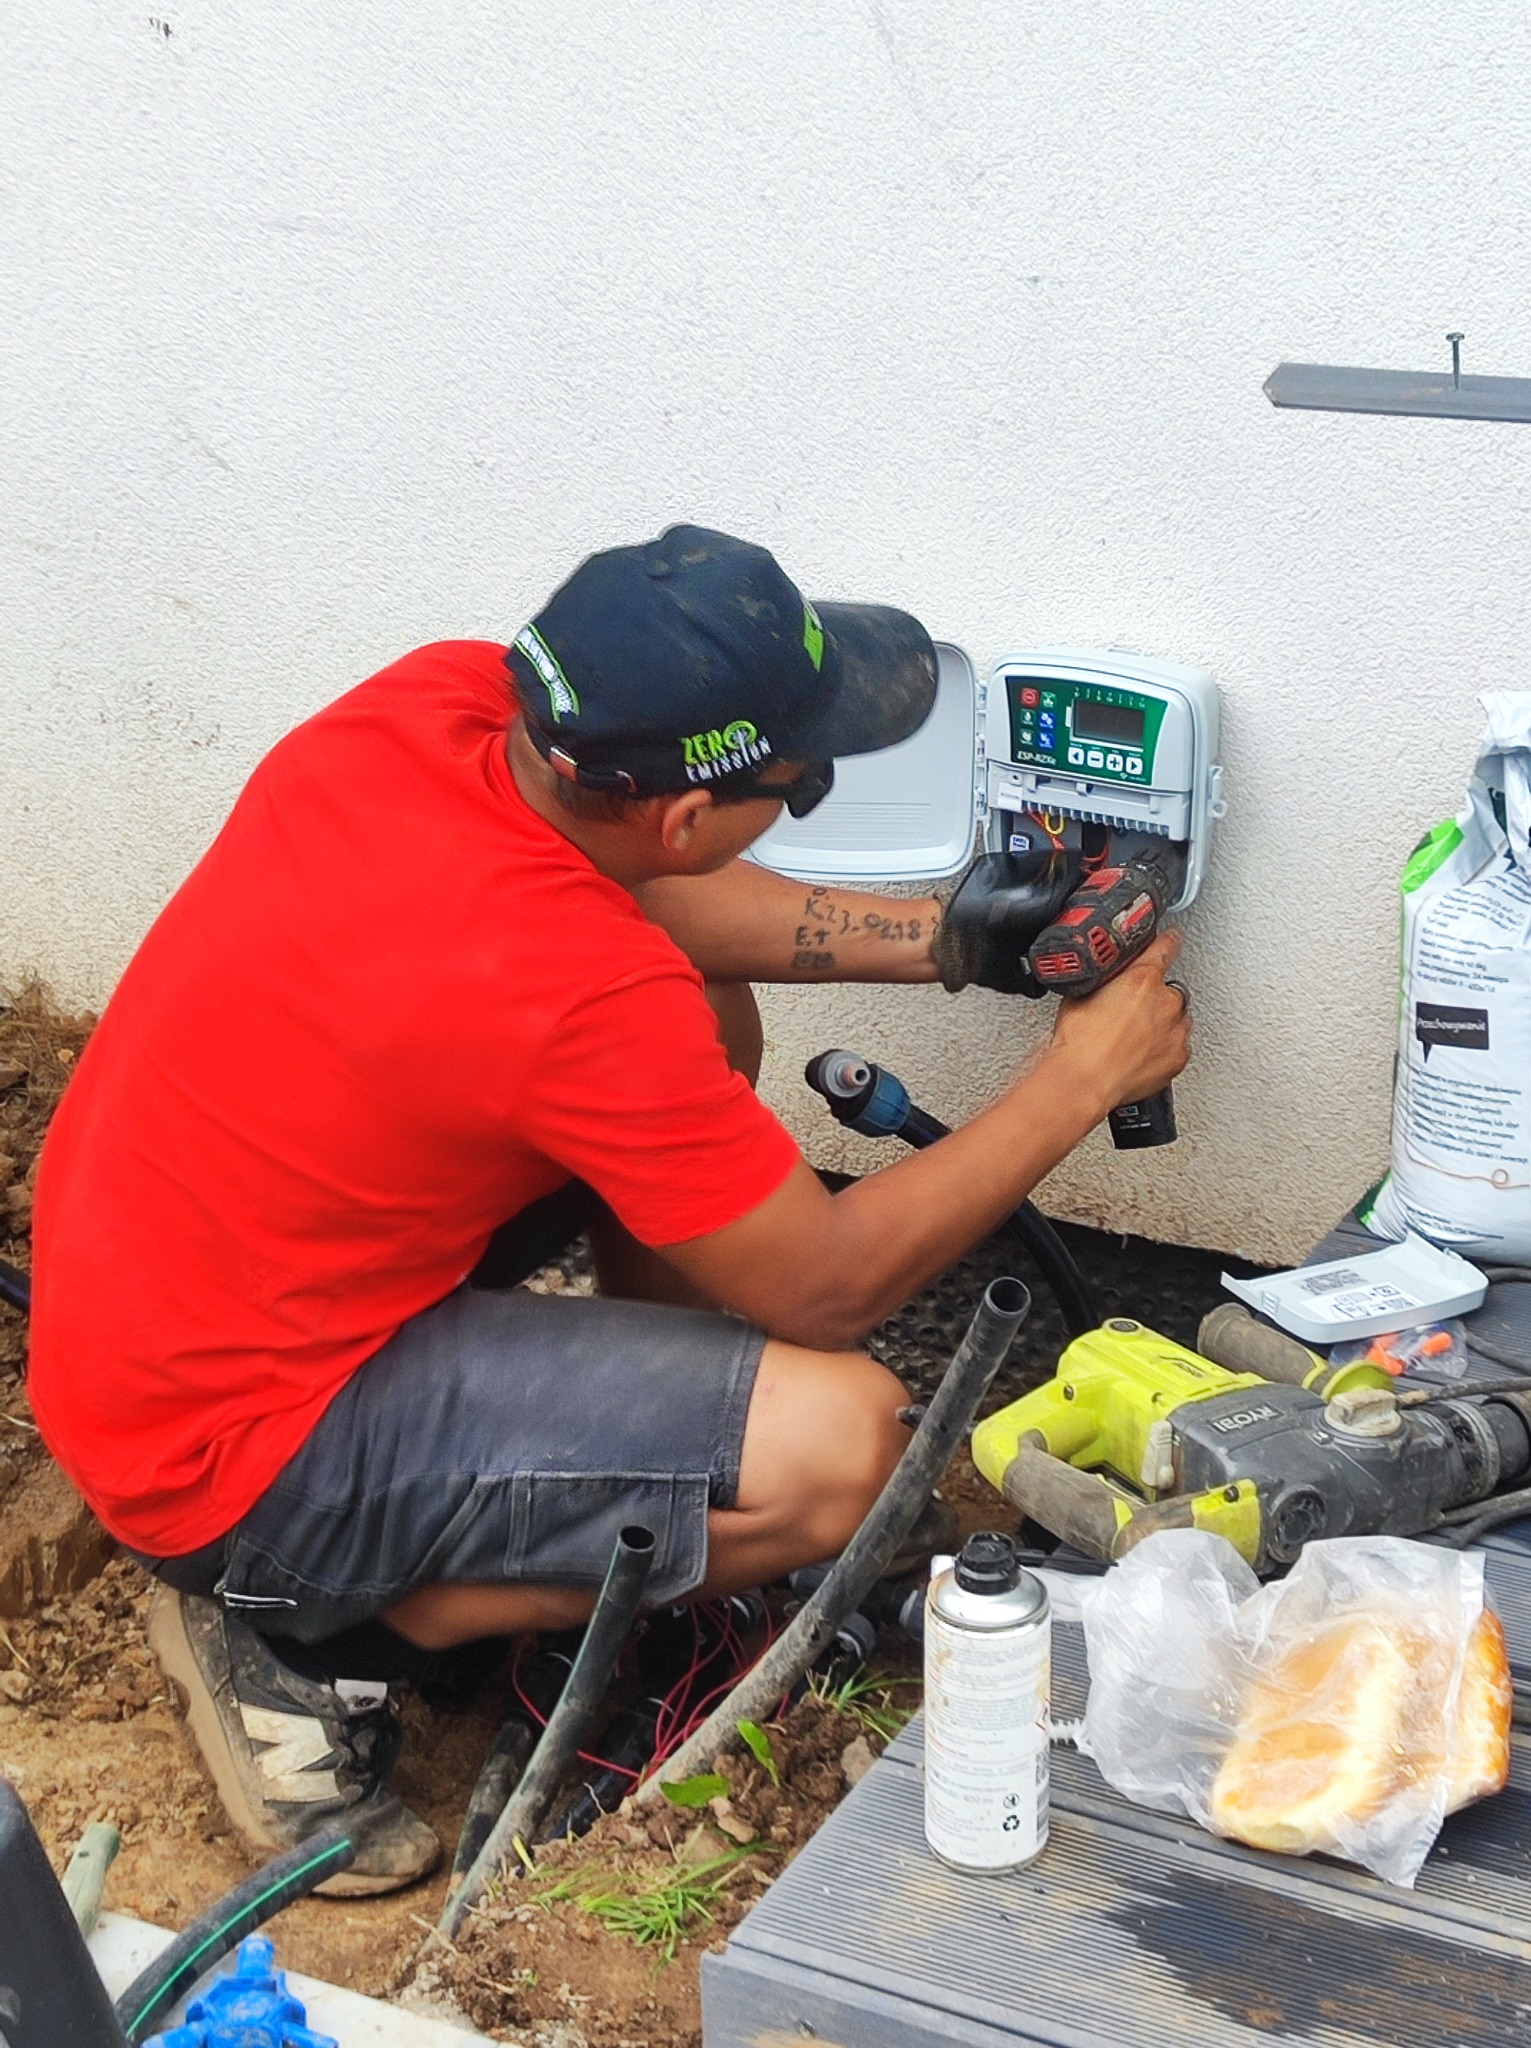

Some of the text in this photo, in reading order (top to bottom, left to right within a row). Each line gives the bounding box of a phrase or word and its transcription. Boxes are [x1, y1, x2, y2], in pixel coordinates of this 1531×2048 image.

[680, 720, 758, 764] ZERO
[685, 735, 772, 782] EMISSION
[1213, 1405, 1278, 1433] RYOBI
